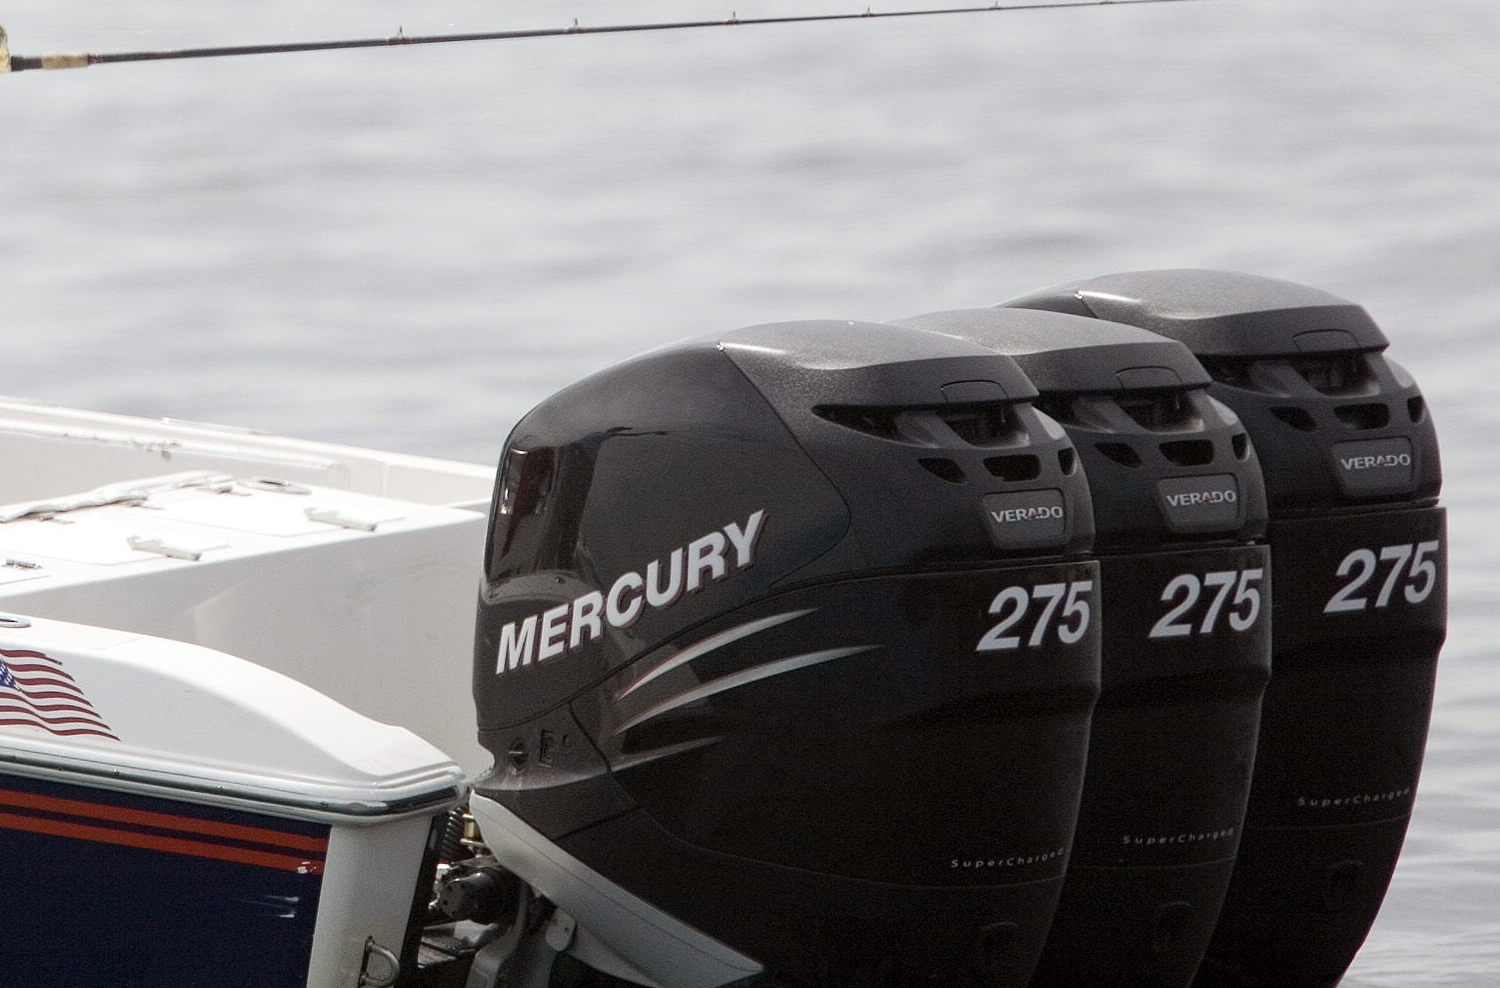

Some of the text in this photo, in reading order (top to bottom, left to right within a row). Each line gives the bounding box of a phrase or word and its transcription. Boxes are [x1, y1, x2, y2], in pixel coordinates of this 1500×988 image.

[1340, 453, 1412, 472] VERADO
[1166, 489, 1237, 508] VERADO
[991, 505, 1064, 524] VERADO
[1323, 539, 1440, 613] 275
[495, 508, 768, 675] MERCURY
[1148, 568, 1264, 639] 275
[975, 580, 1093, 652] 275
[1298, 786, 1410, 807] SuperCharged
[1122, 826, 1235, 846] SuperCharged
[950, 846, 1065, 868] SuperCharged
